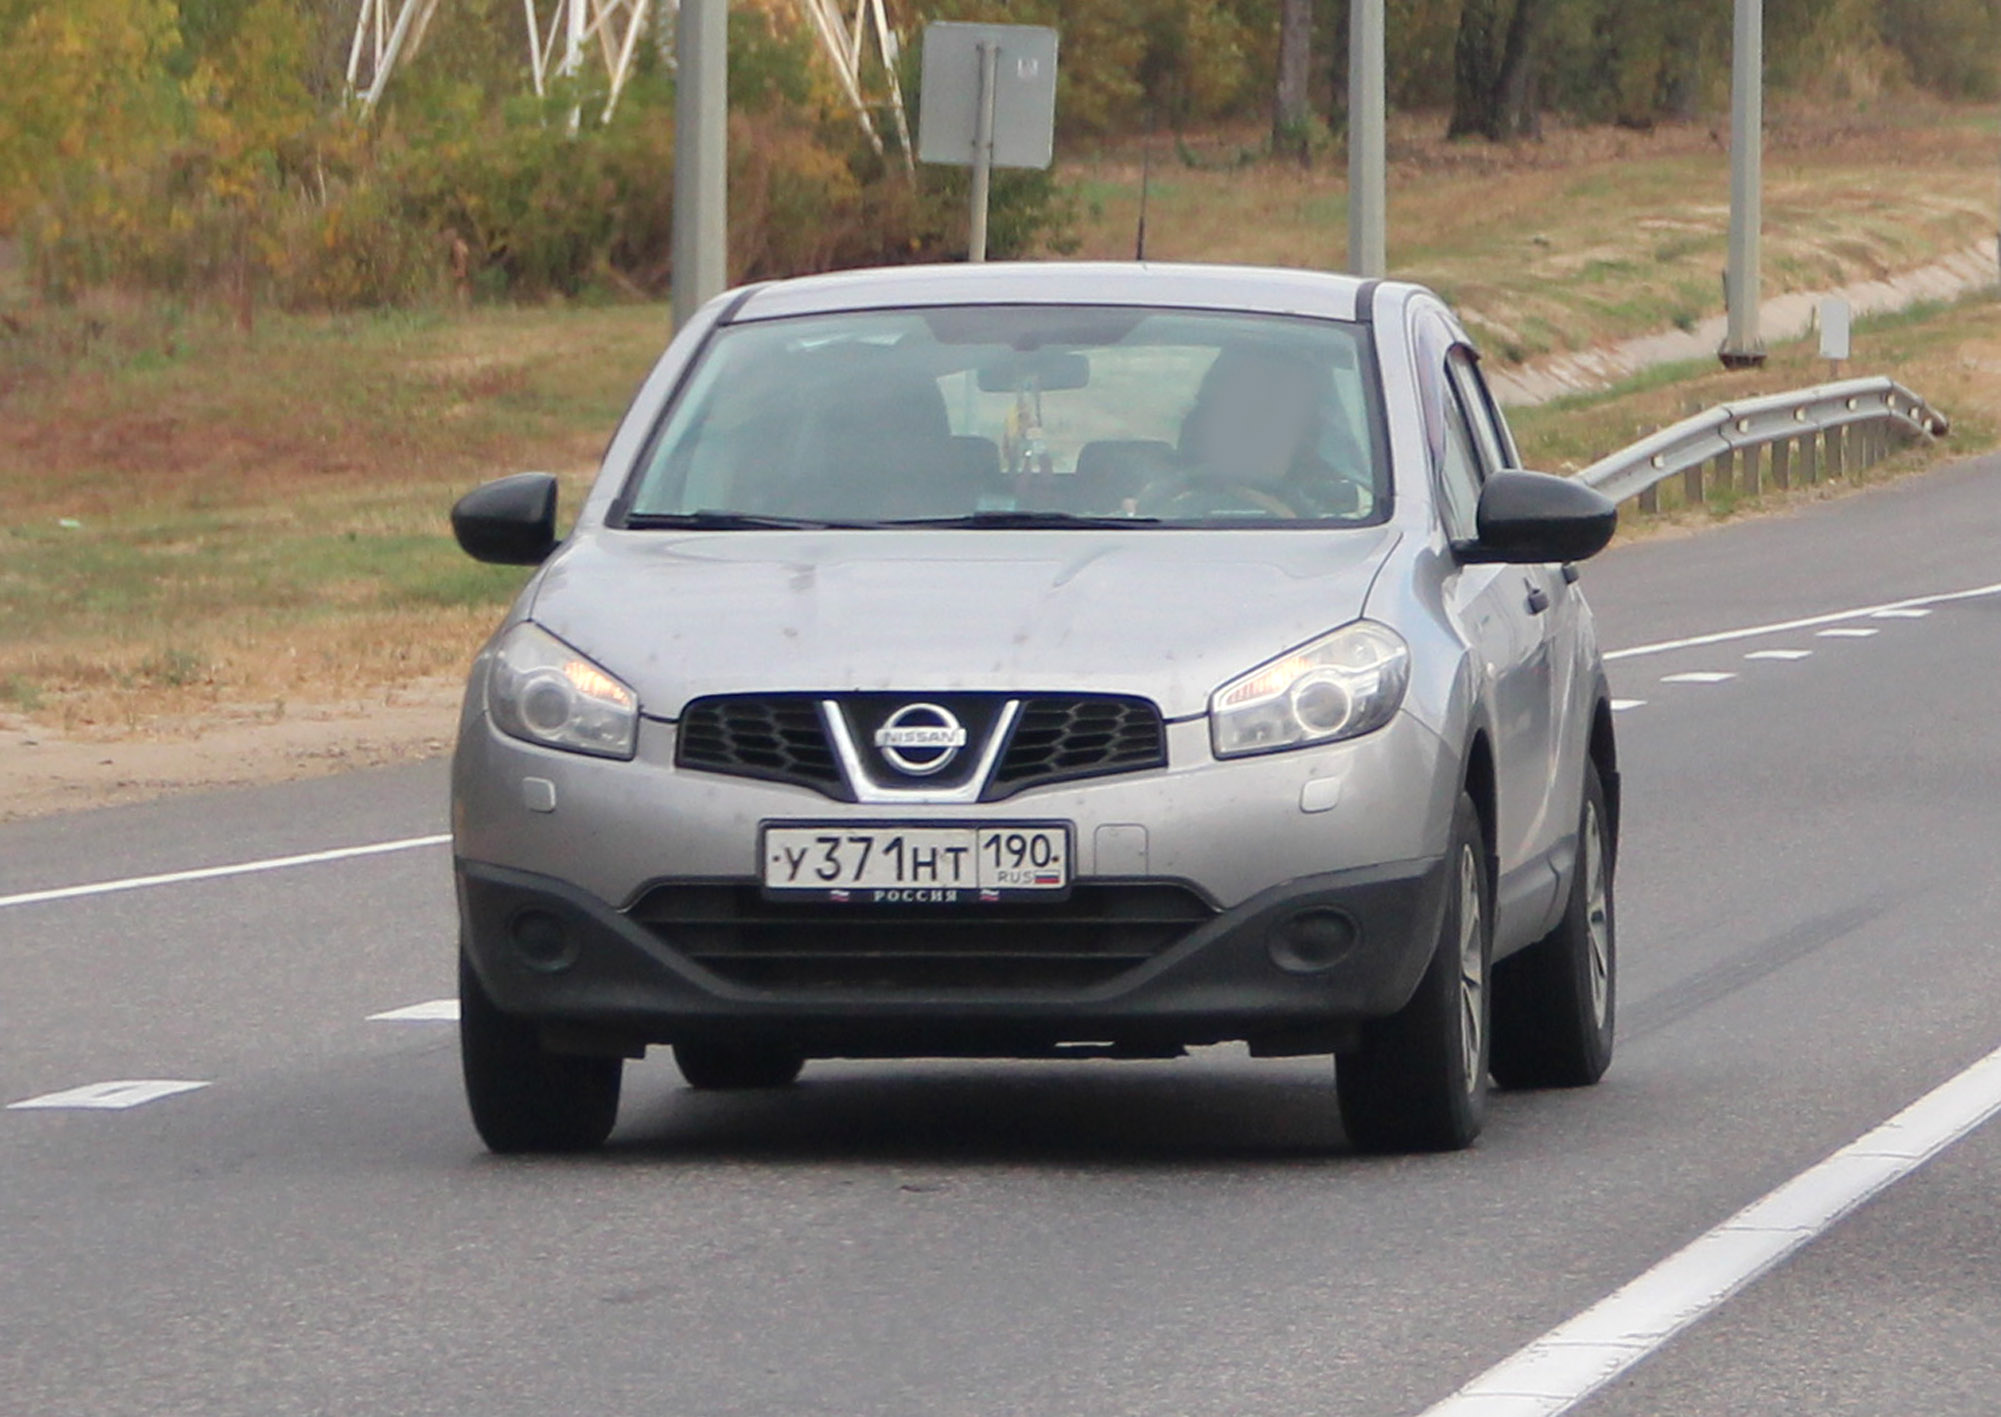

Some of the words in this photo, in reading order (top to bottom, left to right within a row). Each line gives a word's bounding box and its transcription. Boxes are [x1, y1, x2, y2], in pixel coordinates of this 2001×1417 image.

[884, 731, 957, 743] NISSAN
[983, 834, 1051, 868] 190
[997, 871, 1033, 884] RUS
[874, 890, 958, 902] РОССИЯ
